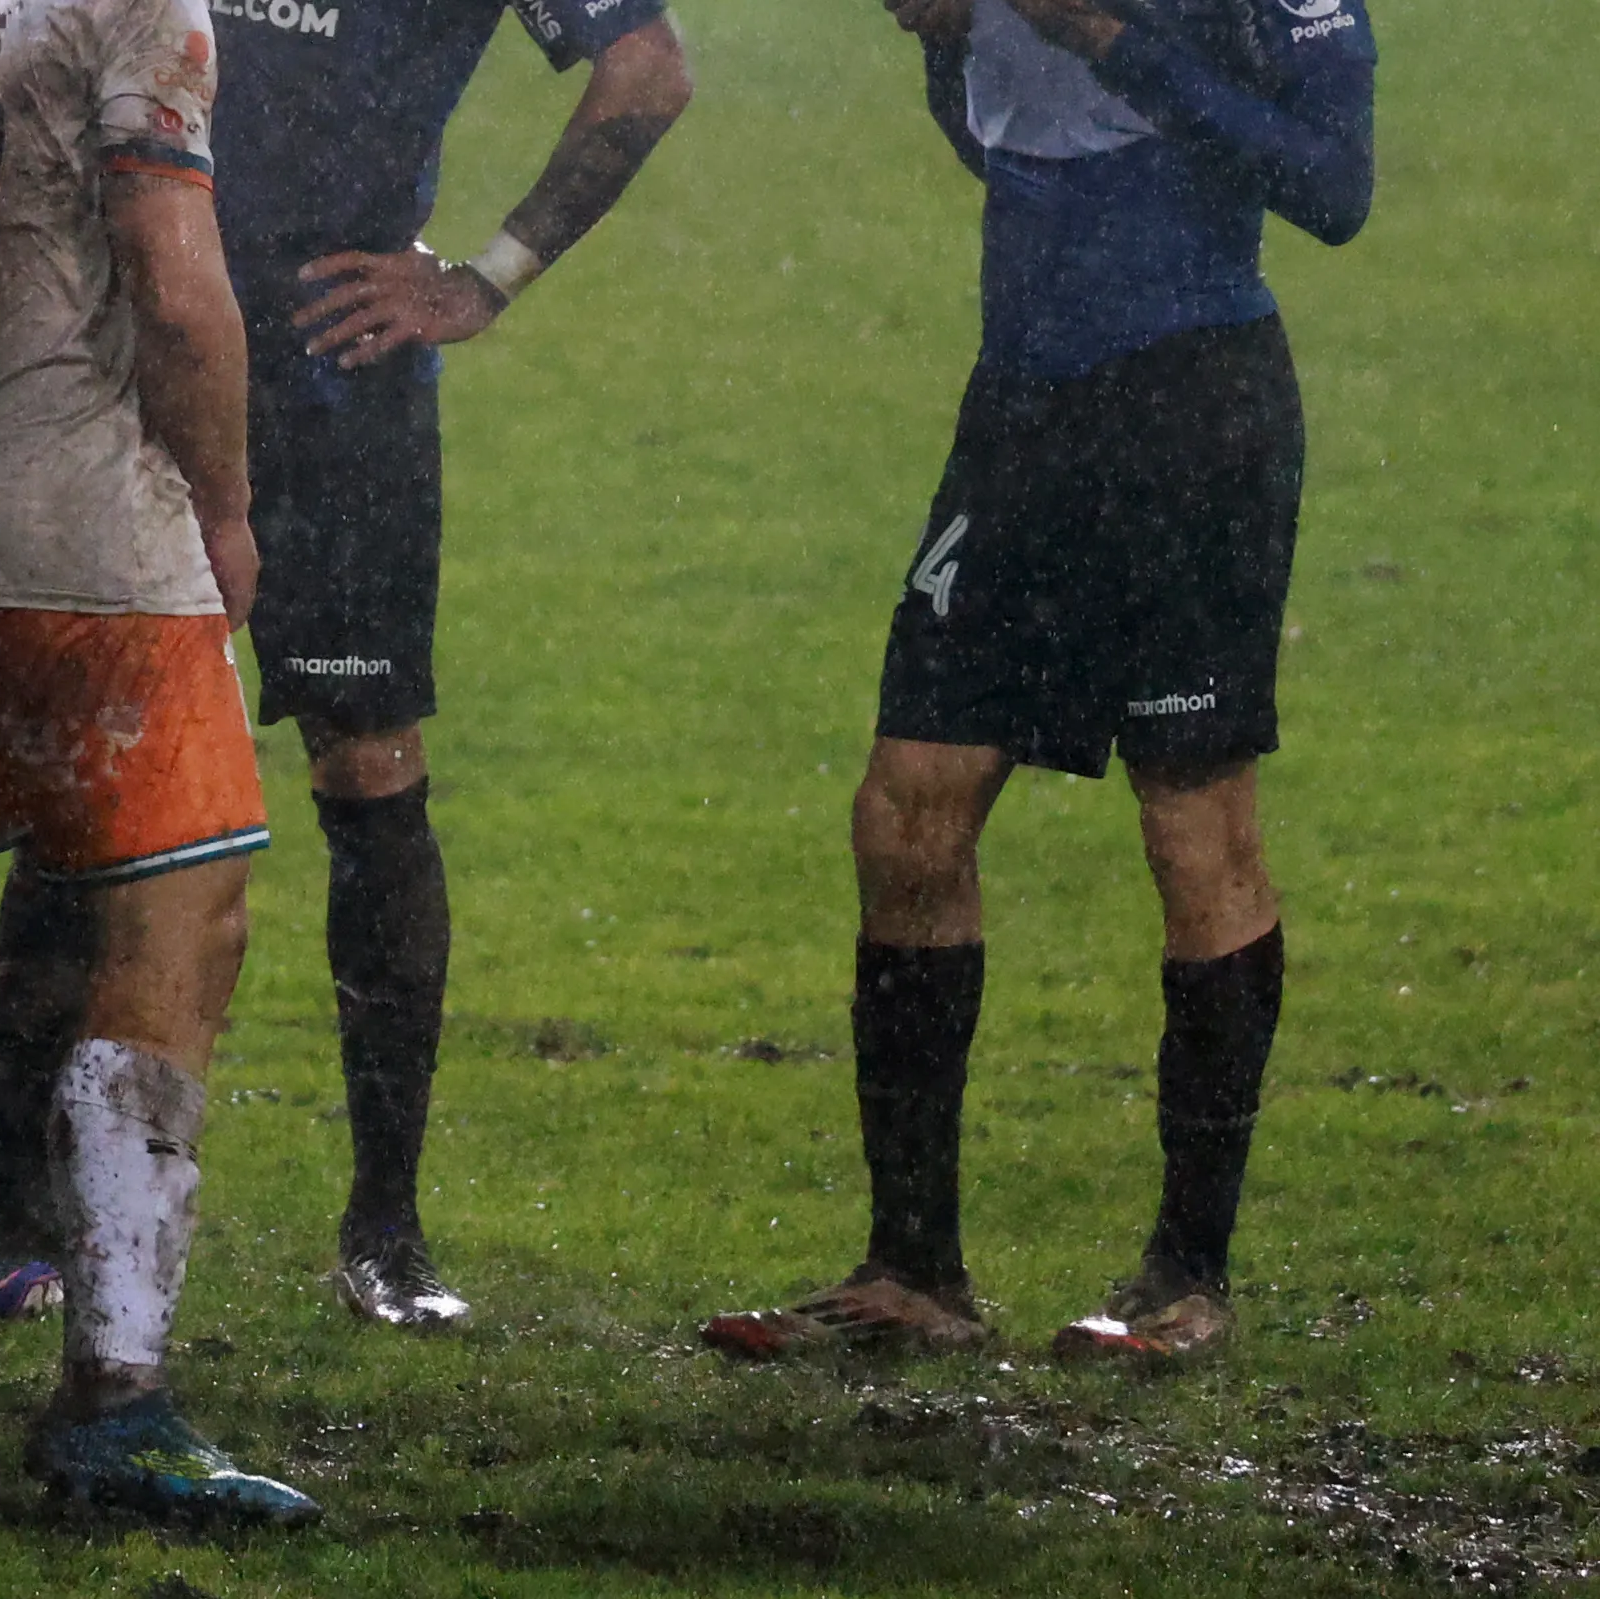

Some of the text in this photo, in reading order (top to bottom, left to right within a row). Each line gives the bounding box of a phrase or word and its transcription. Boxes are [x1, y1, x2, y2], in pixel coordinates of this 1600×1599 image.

[911, 513, 969, 617] 4
[285, 655, 392, 677] marathon
[1127, 690, 1216, 717] marathon
